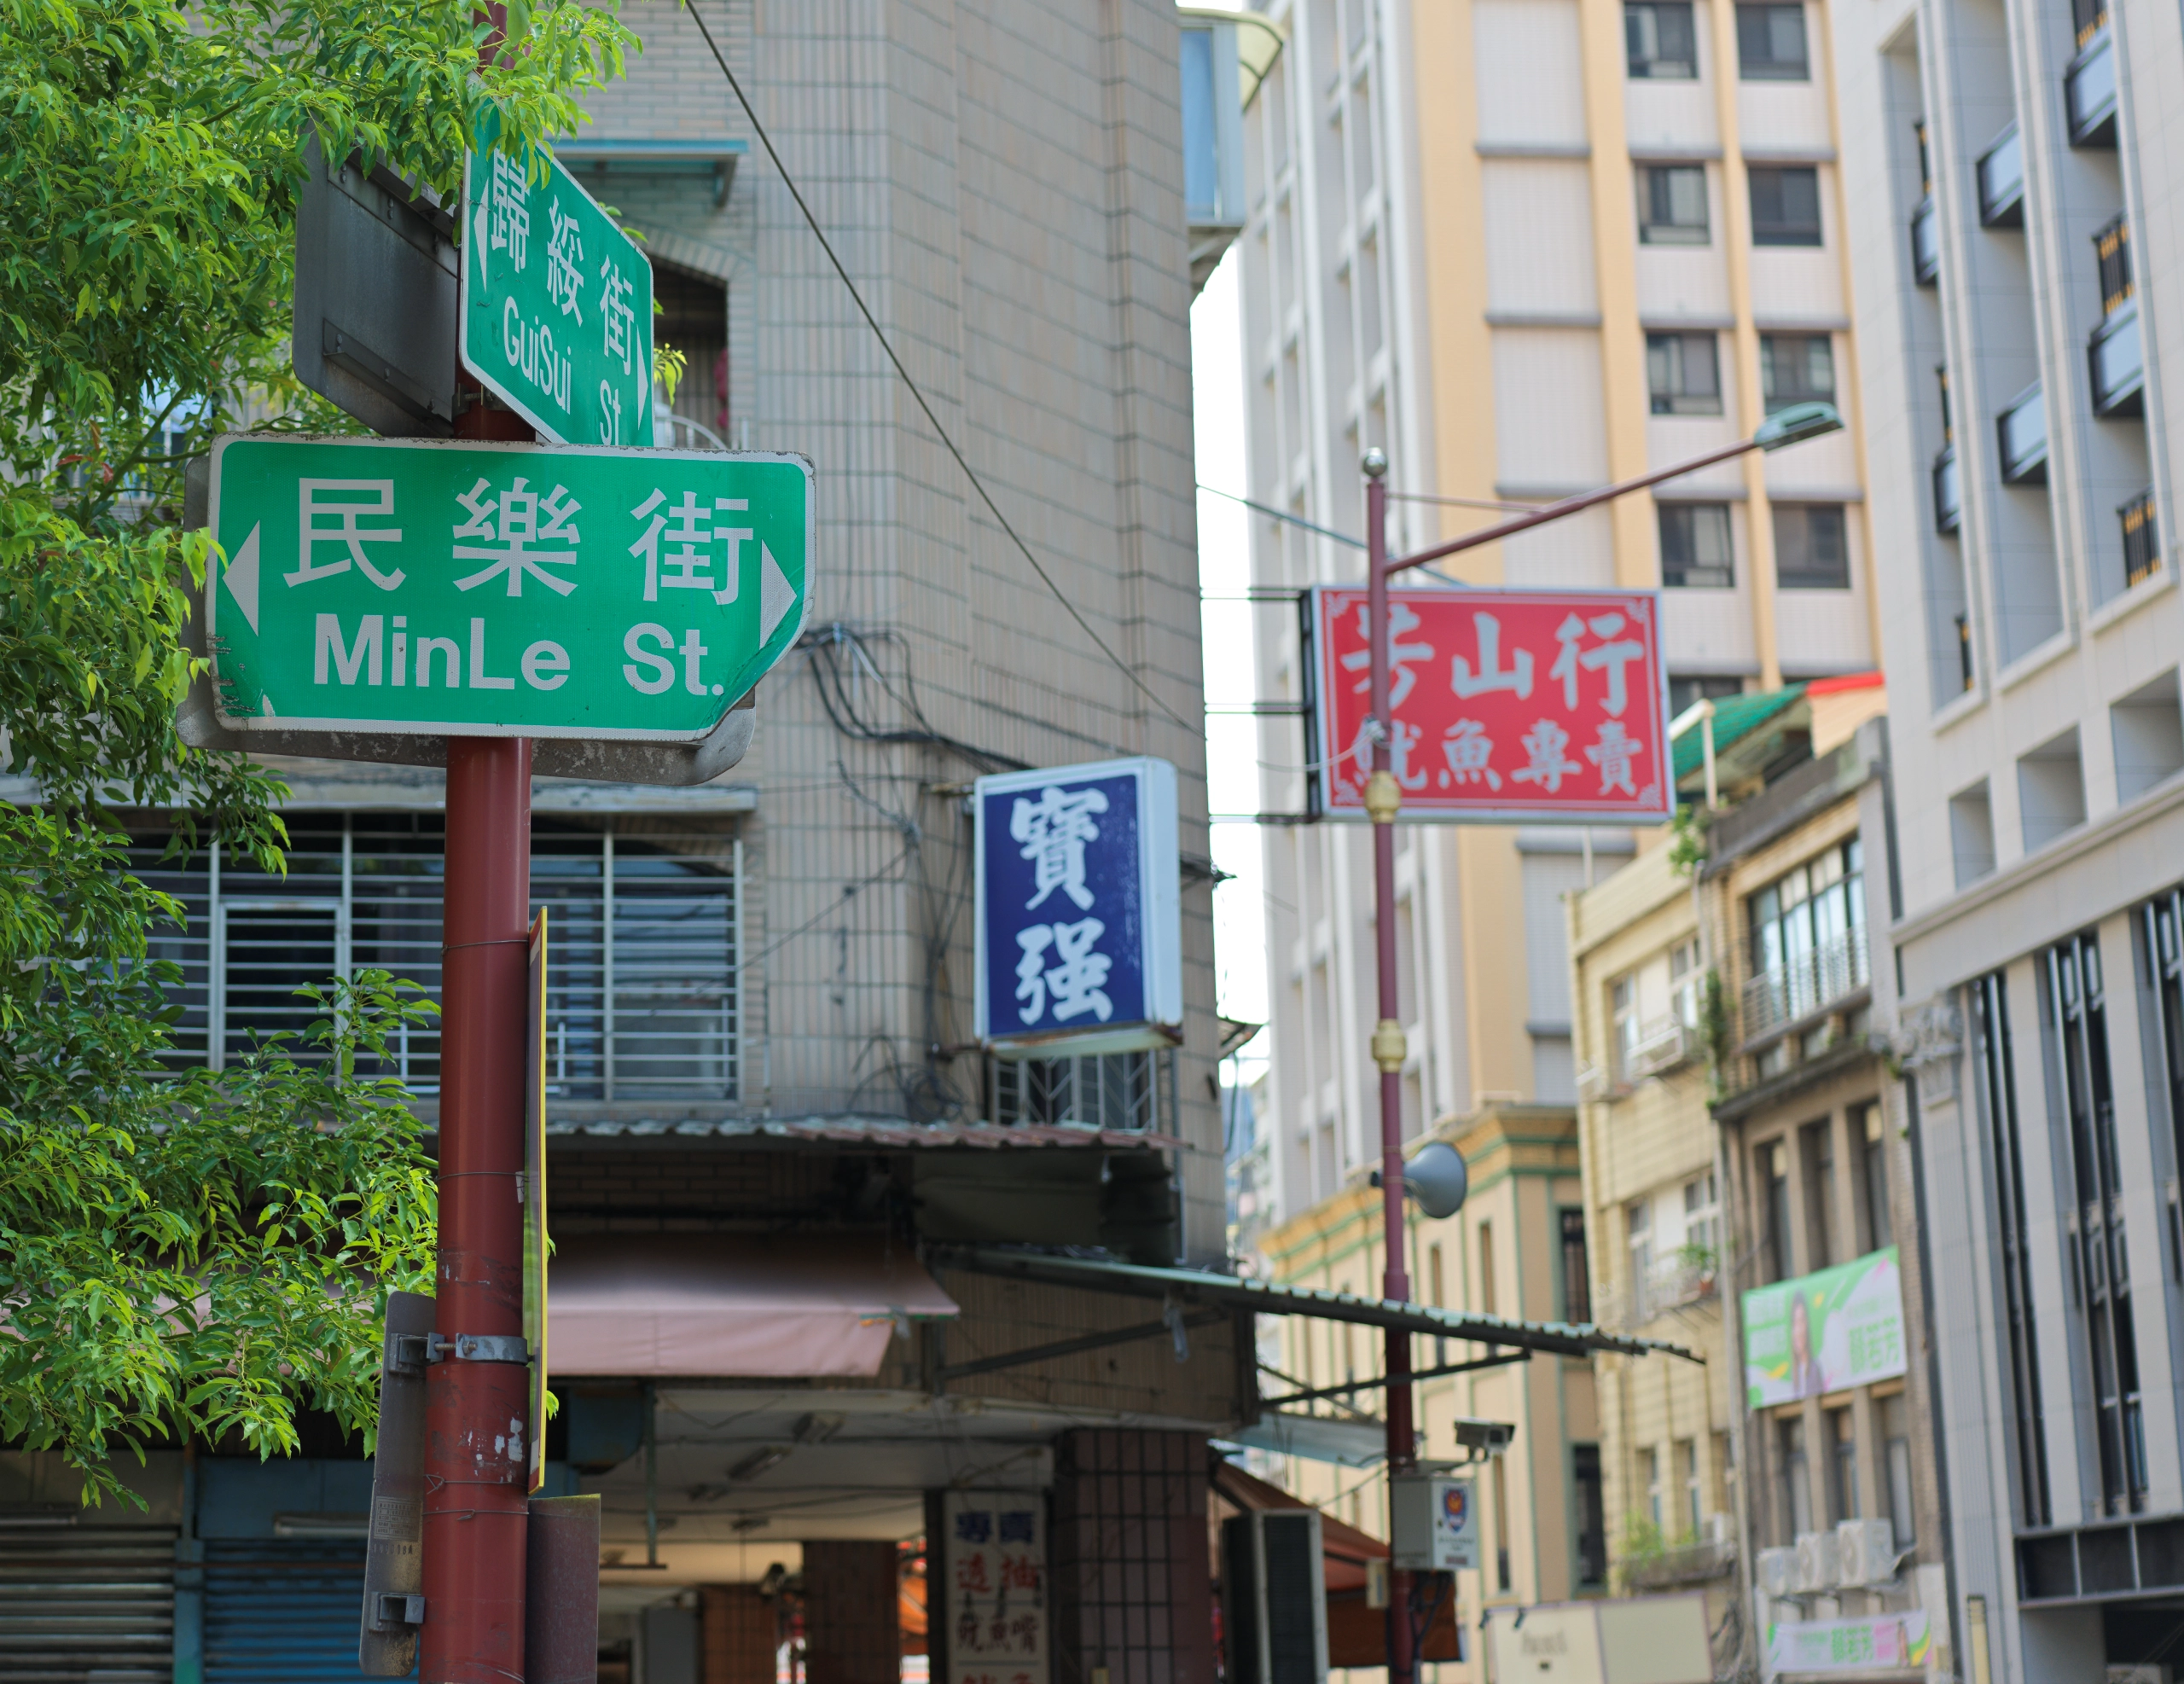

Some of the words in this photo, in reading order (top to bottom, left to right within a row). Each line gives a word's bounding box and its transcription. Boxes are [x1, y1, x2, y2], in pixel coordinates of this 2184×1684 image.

[491, 148, 635, 376] 歸綏街
[503, 296, 572, 415] GuiSui
[282, 476, 754, 606] 民樂街
[313, 613, 571, 691] MinLe
[623, 621, 724, 696] St.
[1339, 602, 1644, 718] 芳山行
